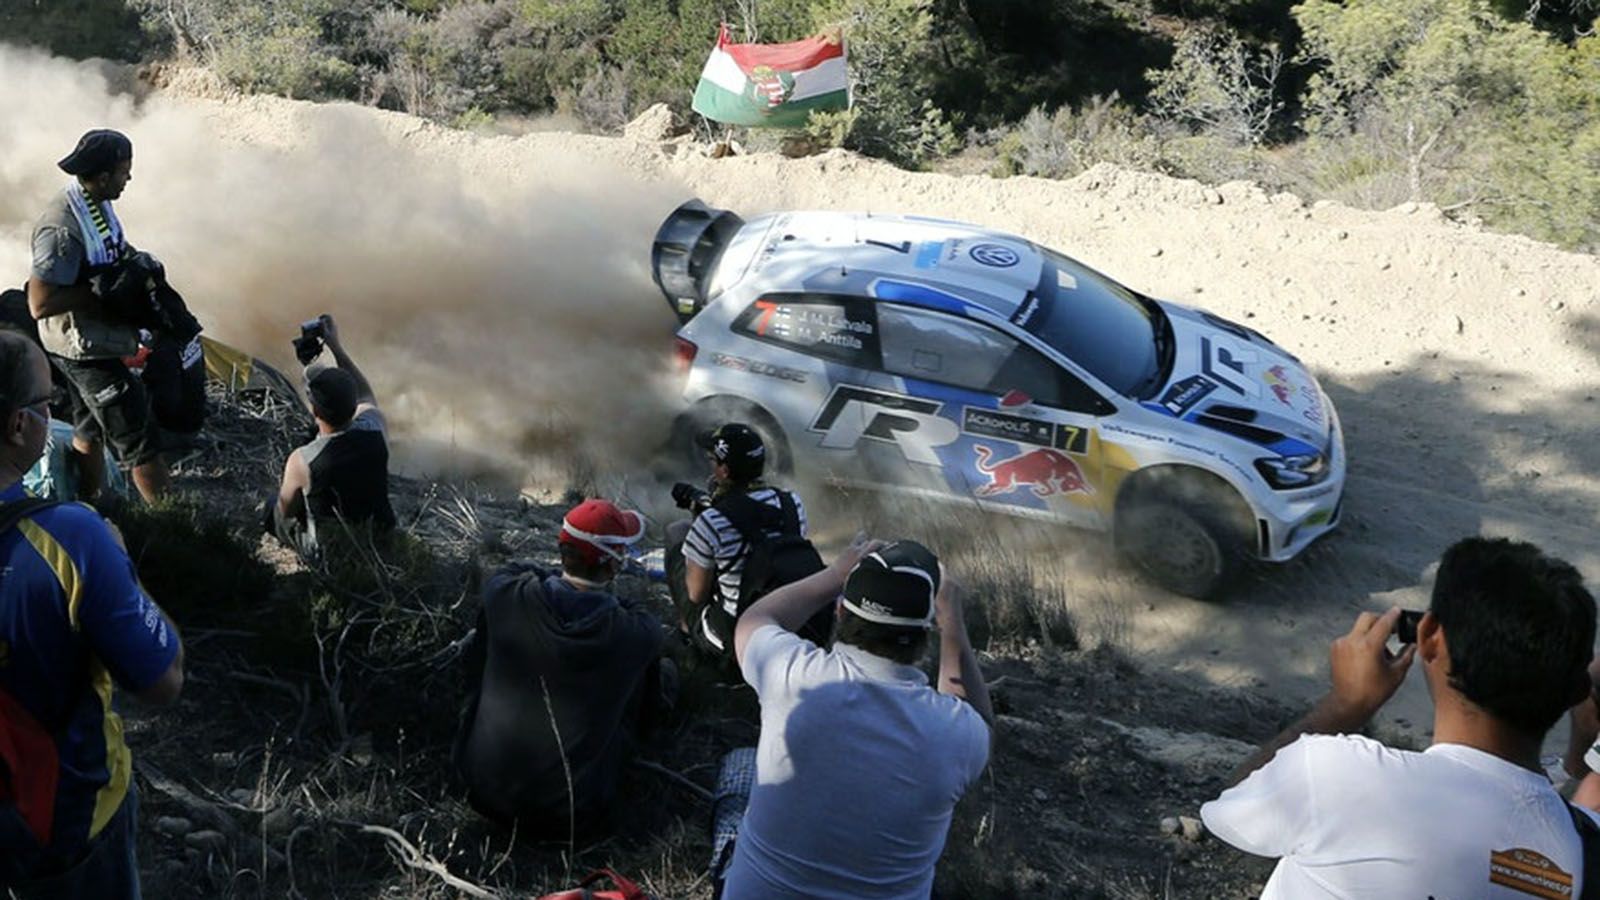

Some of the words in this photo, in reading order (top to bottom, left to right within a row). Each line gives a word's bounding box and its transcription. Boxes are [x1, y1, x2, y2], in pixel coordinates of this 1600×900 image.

[755, 301, 777, 336] 7
[828, 316, 873, 334] Latvala
[817, 331, 863, 349] Anttila
[1062, 426, 1079, 450] 7
